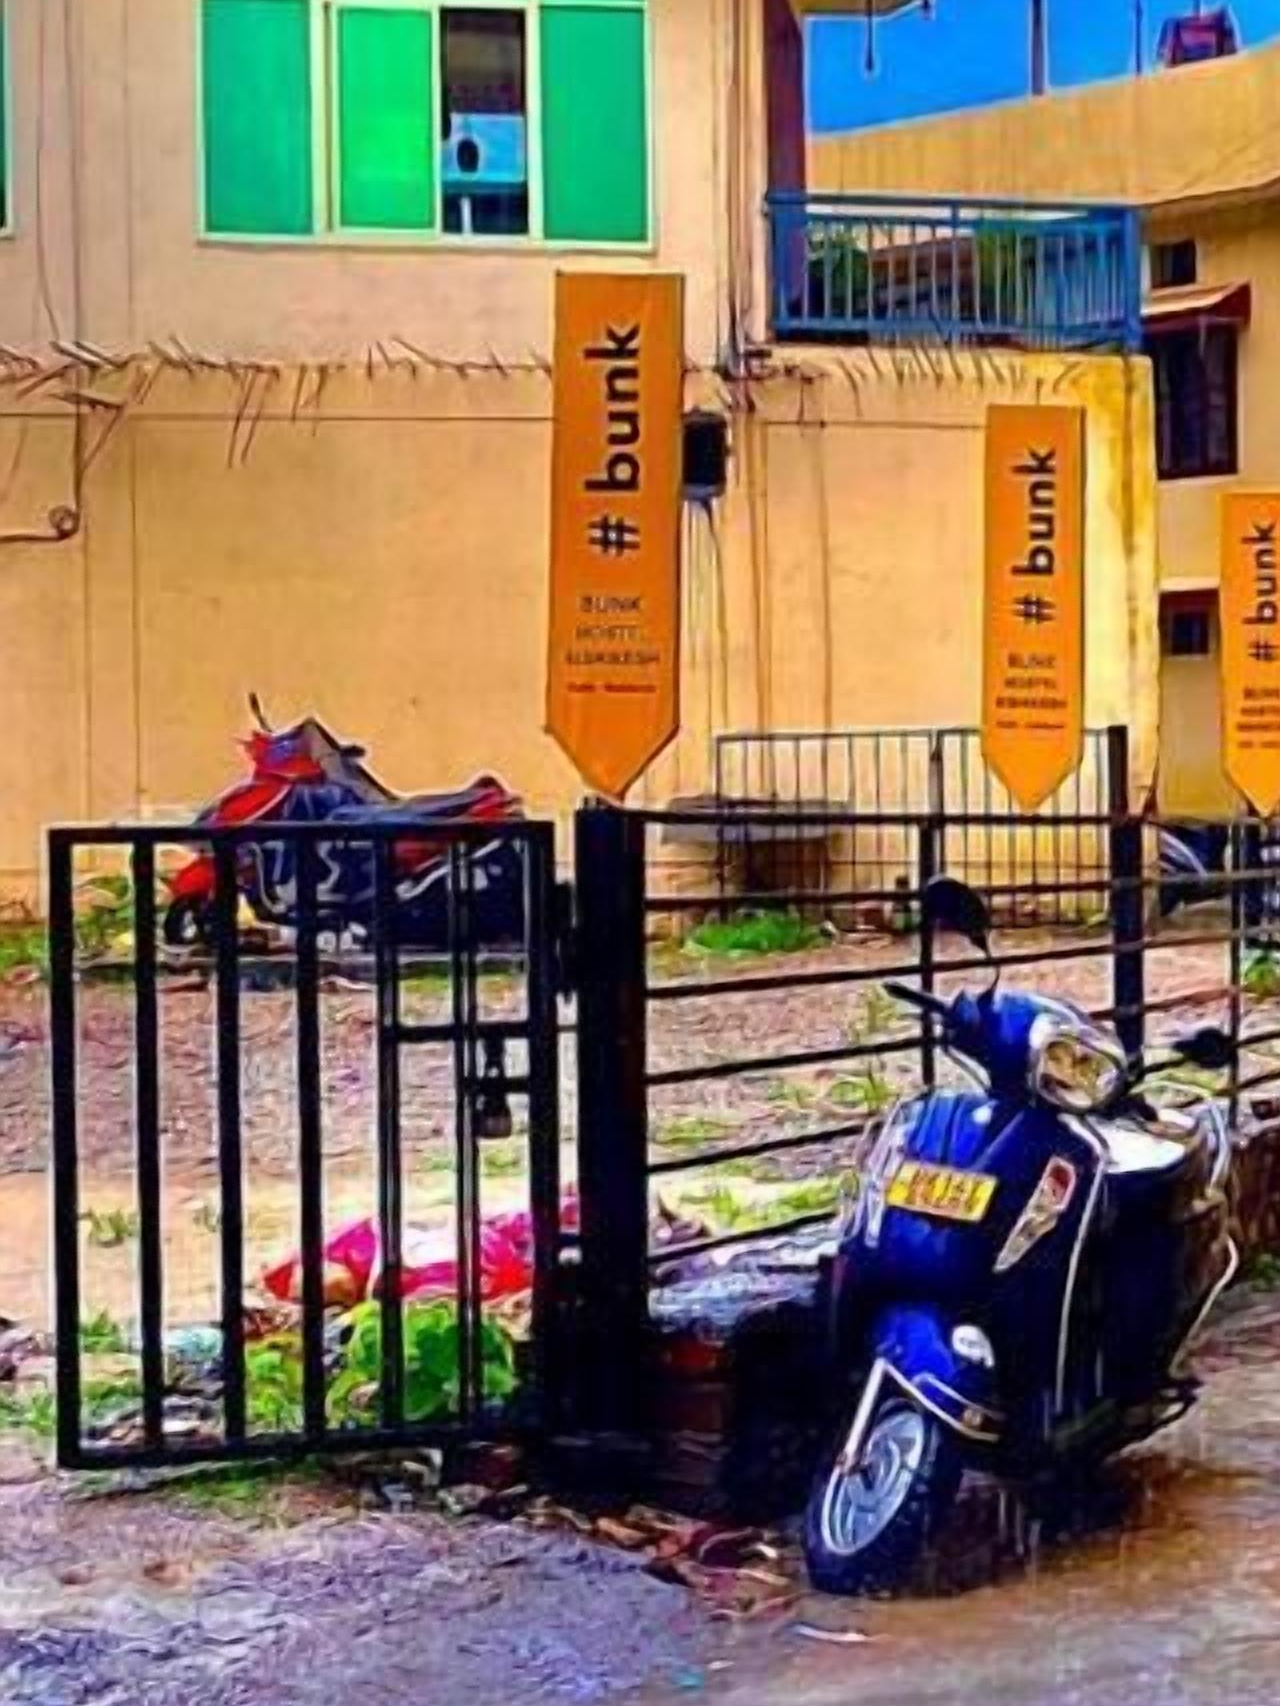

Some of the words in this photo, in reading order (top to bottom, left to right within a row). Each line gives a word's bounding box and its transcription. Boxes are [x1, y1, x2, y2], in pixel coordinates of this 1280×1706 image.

[583, 322, 641, 492] bunk
[1011, 447, 1056, 577] bunk
[1241, 519, 1279, 625] bunk
